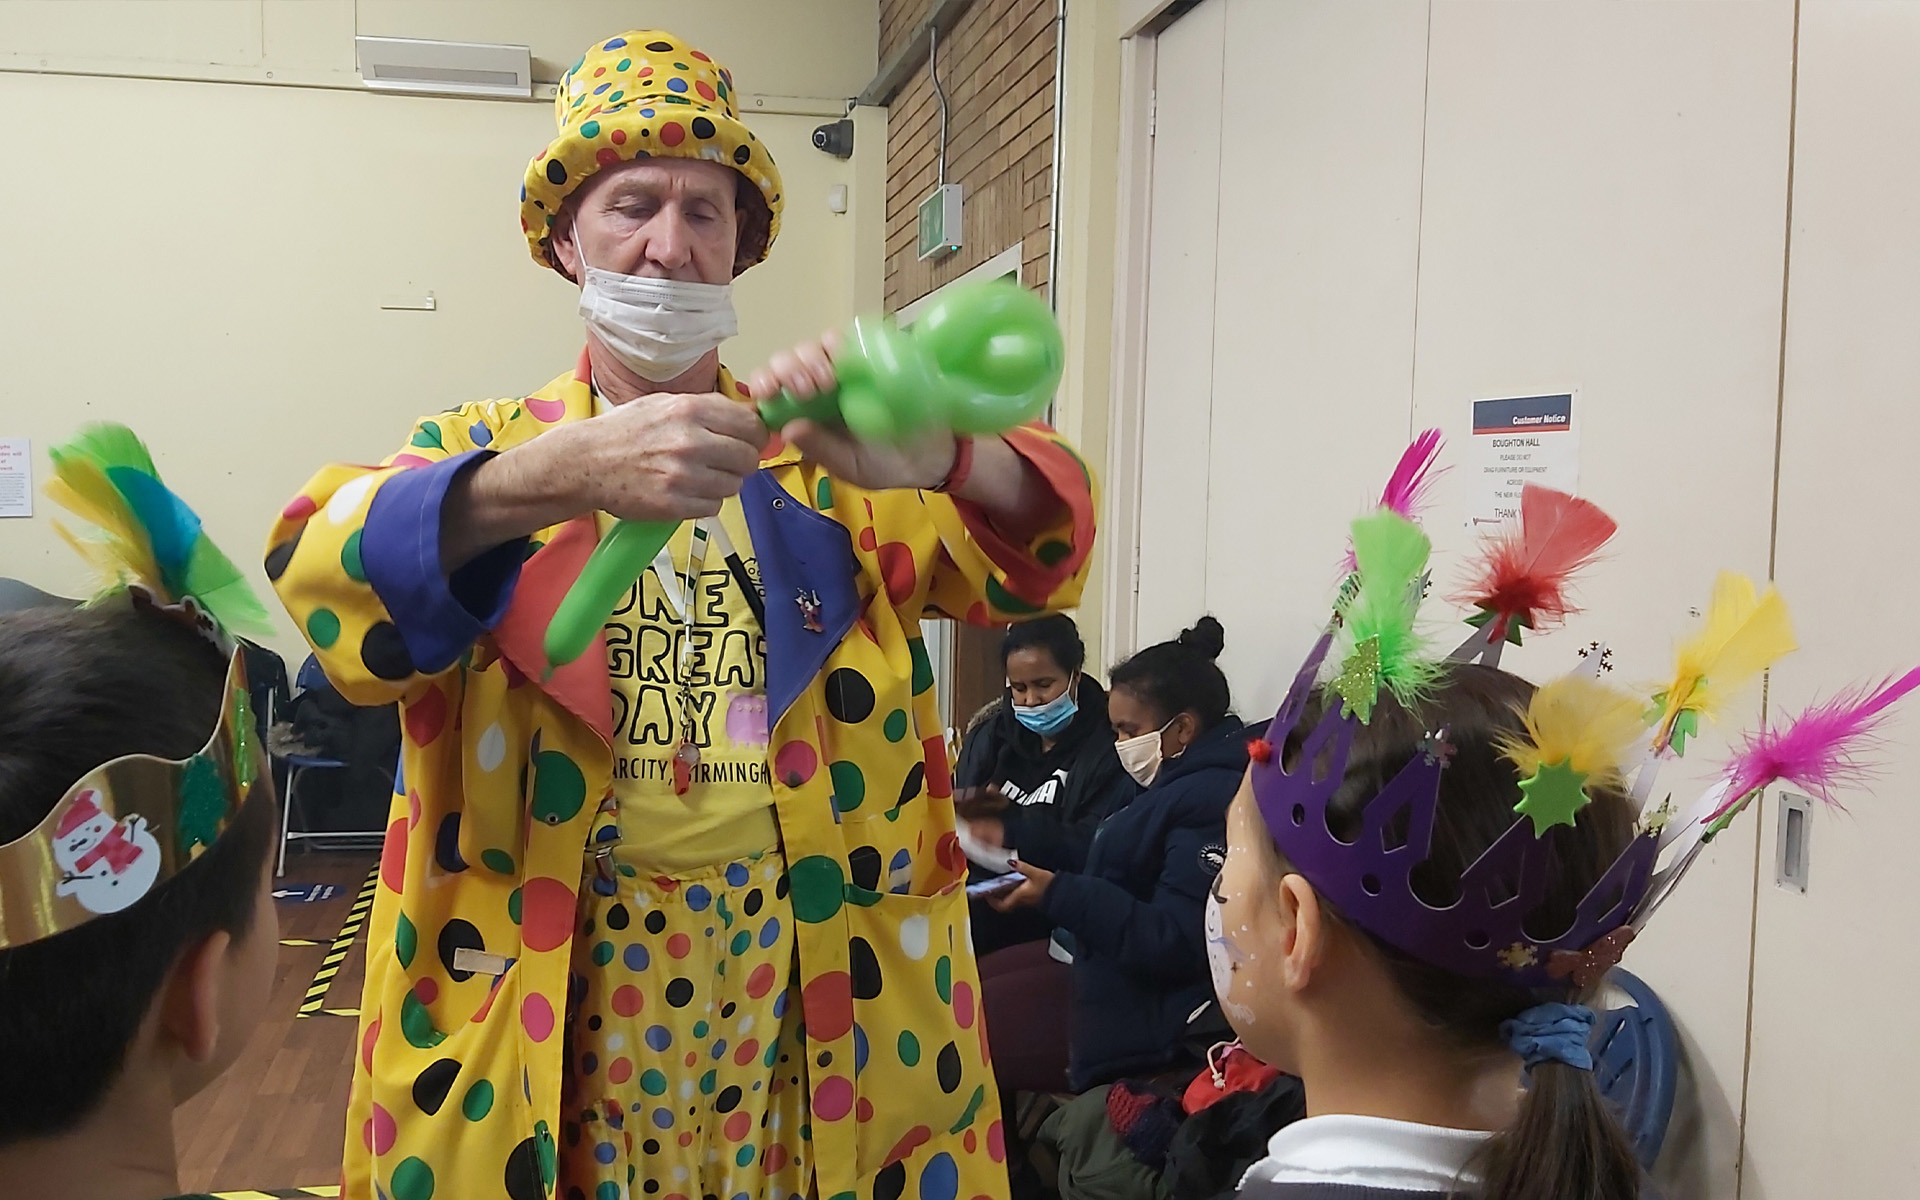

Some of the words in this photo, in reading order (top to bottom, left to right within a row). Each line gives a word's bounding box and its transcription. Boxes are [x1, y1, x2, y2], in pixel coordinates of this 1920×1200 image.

[1512, 416, 1542, 425] Customer
[1543, 414, 1566, 424] Notice
[1492, 439, 1525, 447] BOUGHTON
[1525, 438, 1540, 446] HALL
[1494, 508, 1517, 518] THANK
